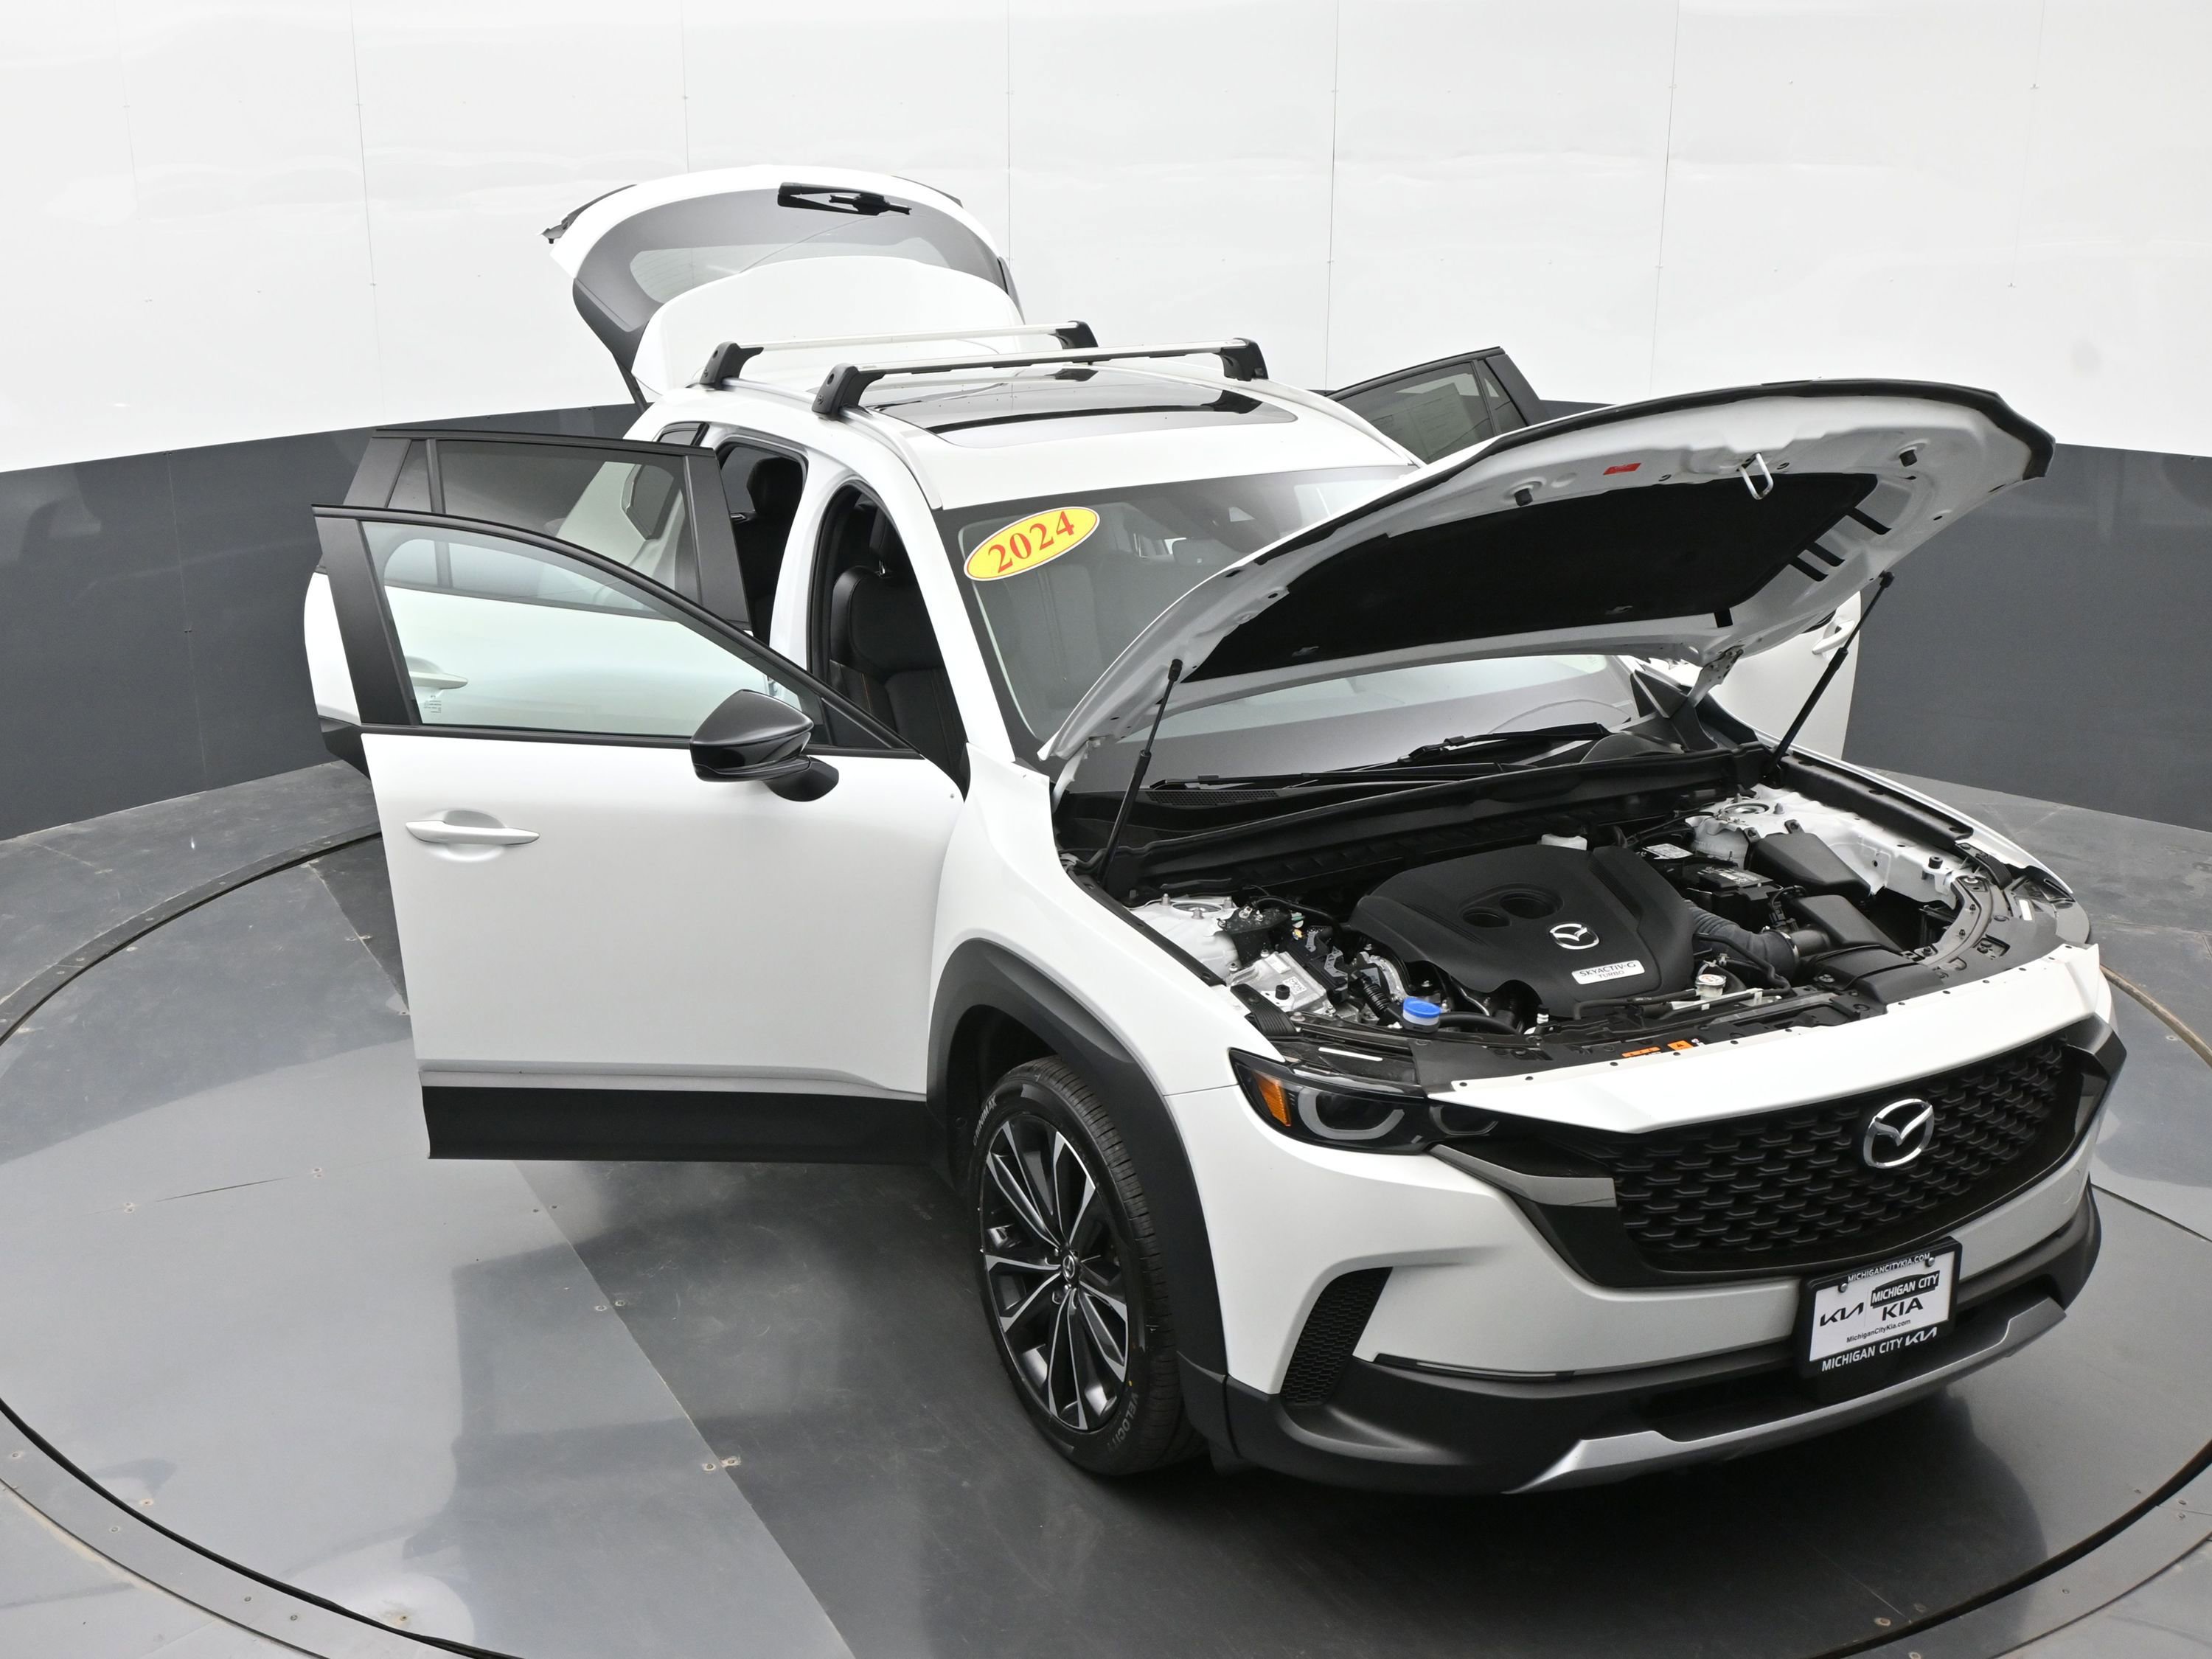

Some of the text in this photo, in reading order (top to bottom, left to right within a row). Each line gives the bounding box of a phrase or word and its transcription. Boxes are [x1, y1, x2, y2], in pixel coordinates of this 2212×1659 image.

[988, 511, 1074, 573] 2024
[1579, 961, 1636, 977] SKYACTIV-G
[1599, 970, 1625, 978] TURBO
[1848, 1253, 1930, 1283] MICHIGANCITYKIA.COM
[1872, 1274, 1938, 1304] MICHIGAN CITY
[1882, 1297, 1923, 1321] KIA
[1846, 1319, 1911, 1343] MichiganCityKia.com
[1822, 1346, 1875, 1371] MICHIGAN
[1879, 1337, 1902, 1354] CITY
